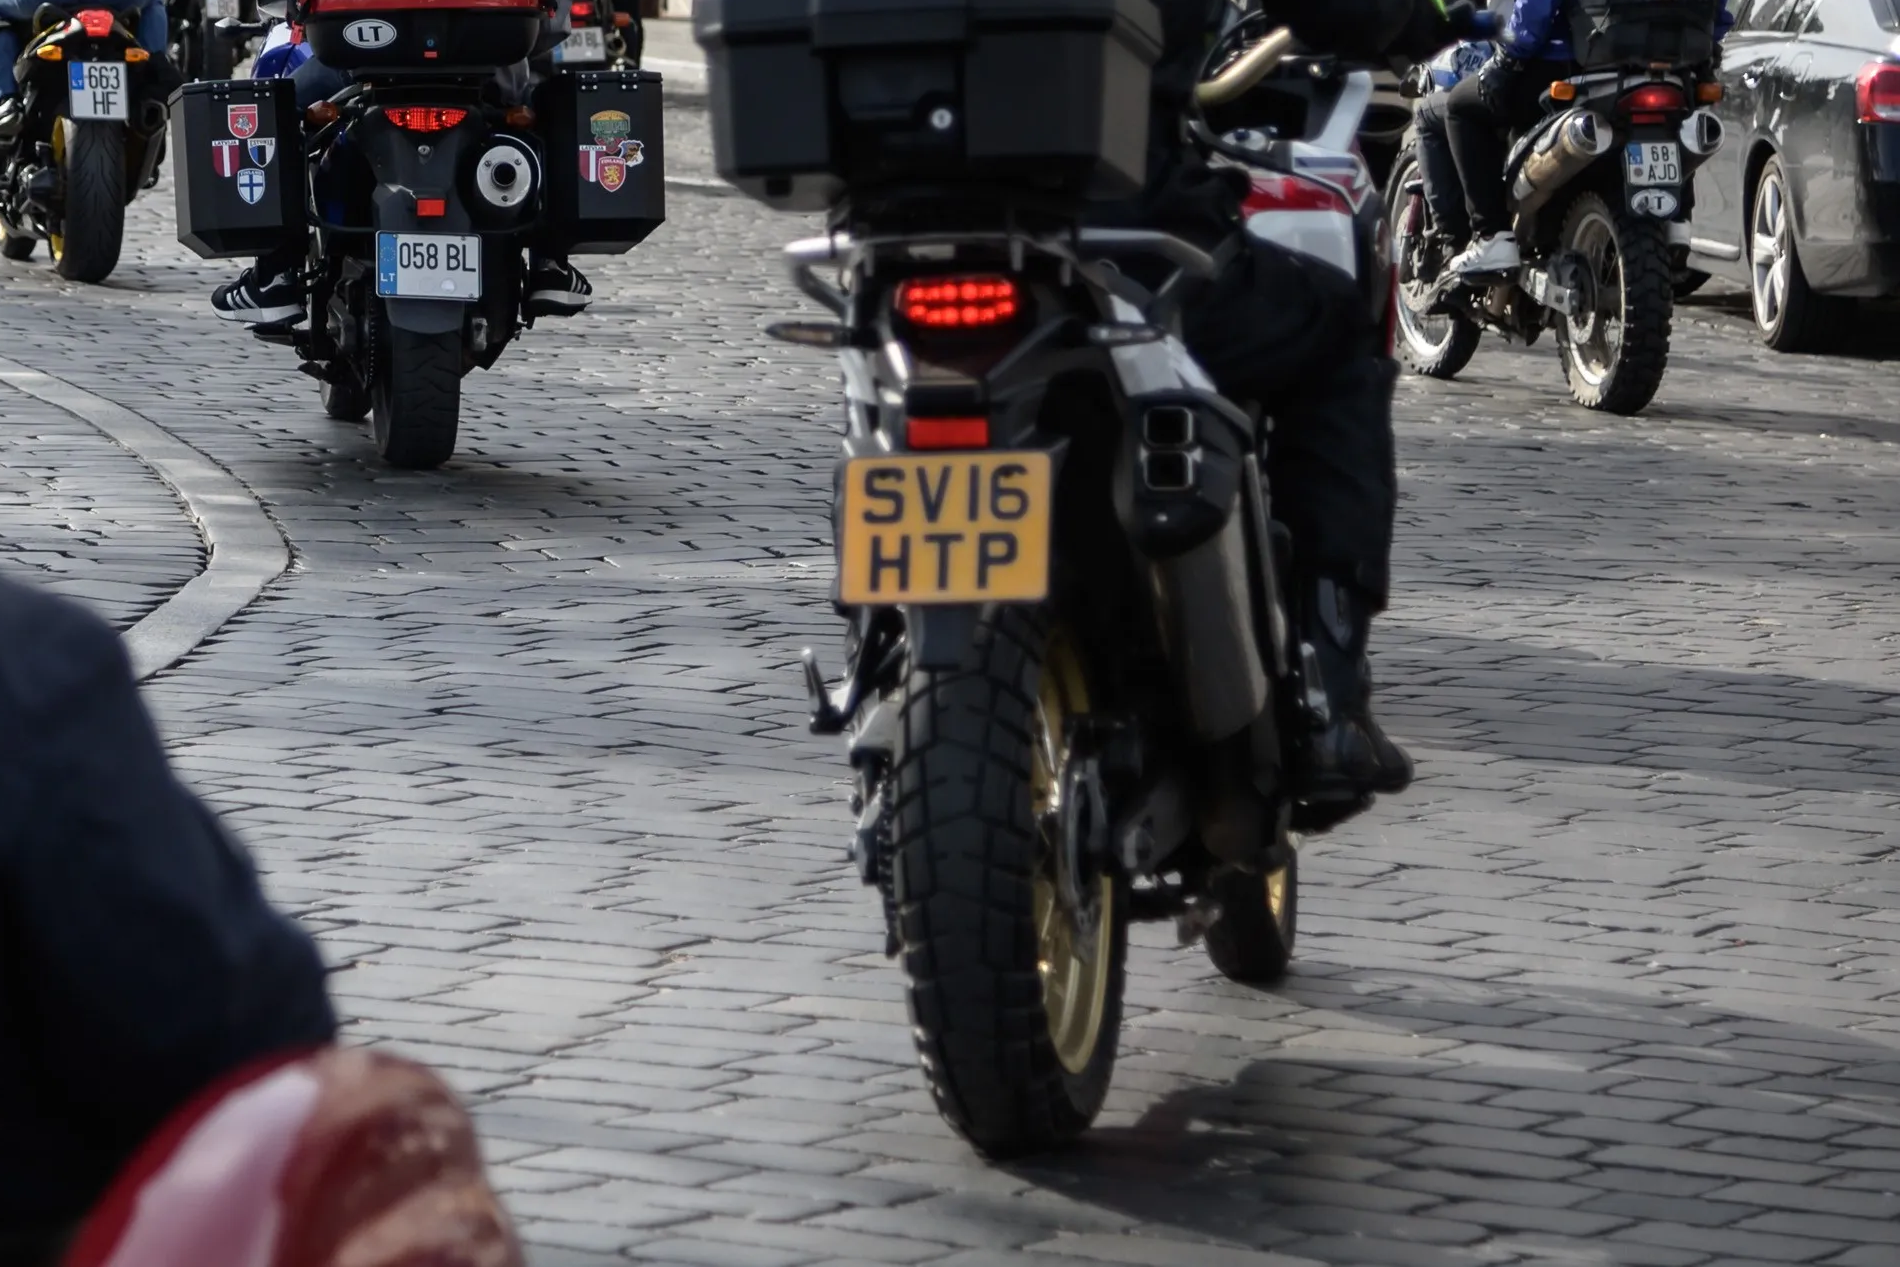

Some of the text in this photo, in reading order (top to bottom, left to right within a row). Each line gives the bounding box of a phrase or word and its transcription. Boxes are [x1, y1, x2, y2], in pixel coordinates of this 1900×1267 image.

[357, 25, 382, 42] LT
[88, 66, 120, 89] 663
[93, 91, 117, 115] HF
[1648, 163, 1677, 181] AJD
[400, 242, 476, 272] 058 BL
[380, 272, 395, 282] LT
[863, 464, 1029, 524] SV16
[870, 532, 1019, 592] HTP
